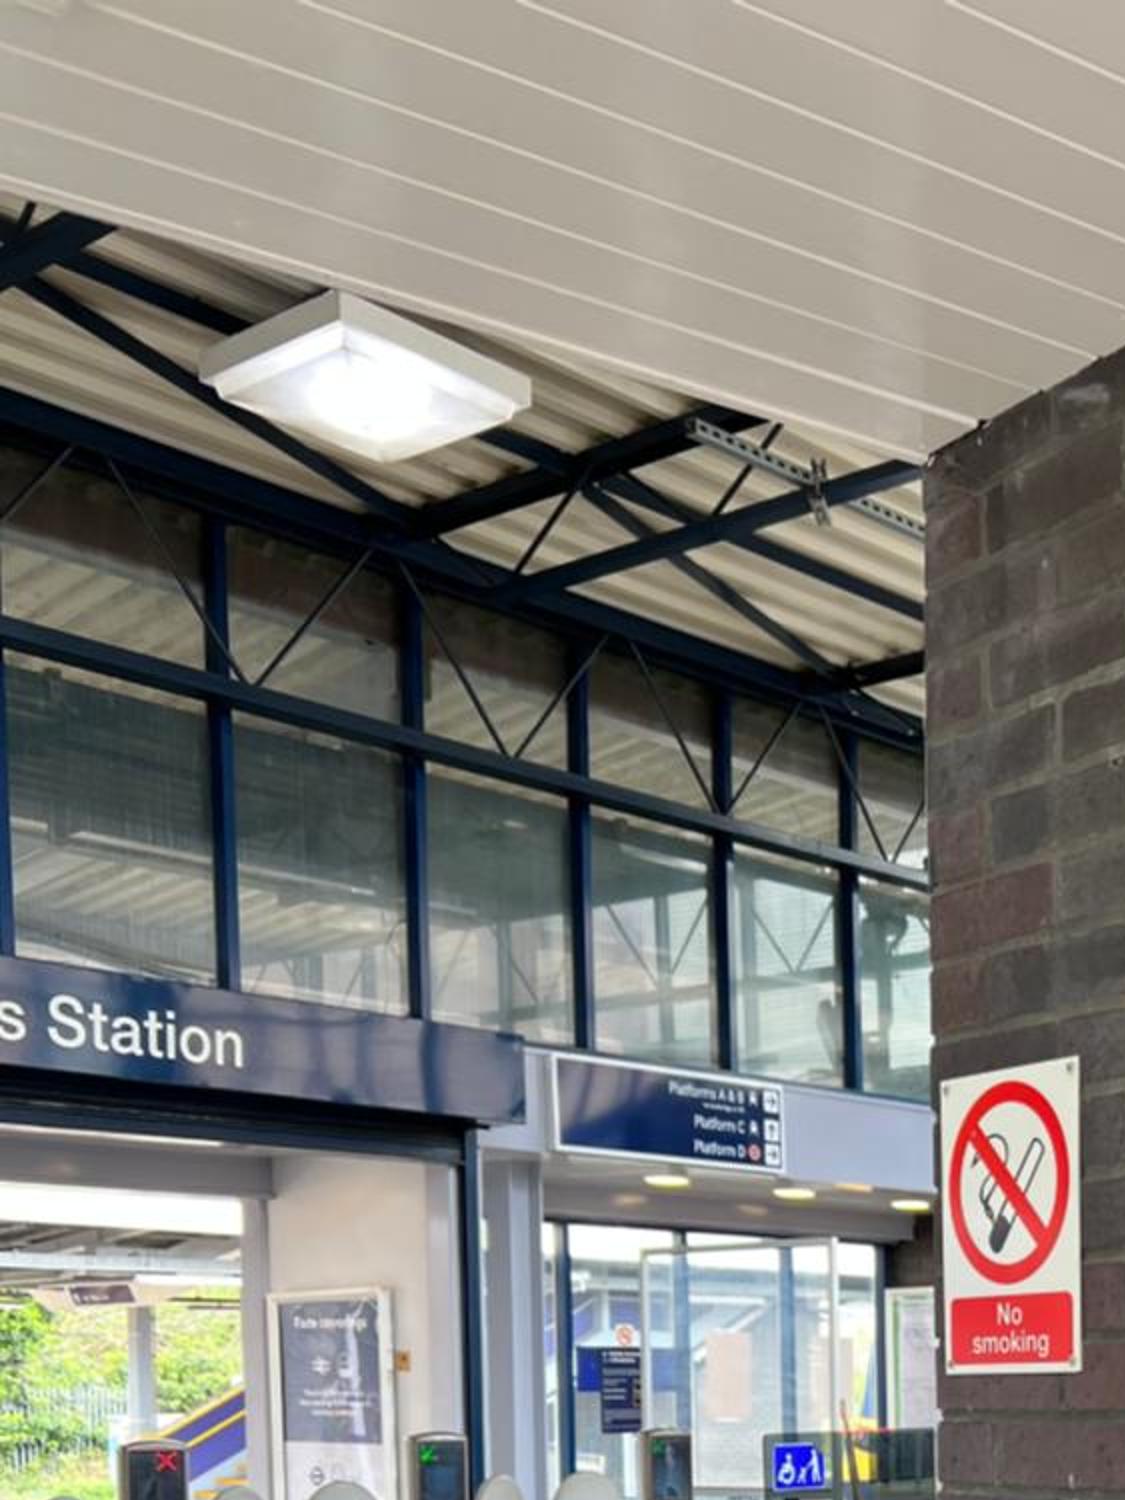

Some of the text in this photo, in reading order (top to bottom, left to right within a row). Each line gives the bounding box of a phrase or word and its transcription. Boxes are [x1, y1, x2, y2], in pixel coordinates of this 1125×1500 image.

[47, 994, 244, 1069] Station
[693, 1113, 736, 1132] Platform
[693, 1139, 736, 1158] Platform
[997, 1303, 1023, 1325] No
[972, 1330, 1050, 1357] smoking
